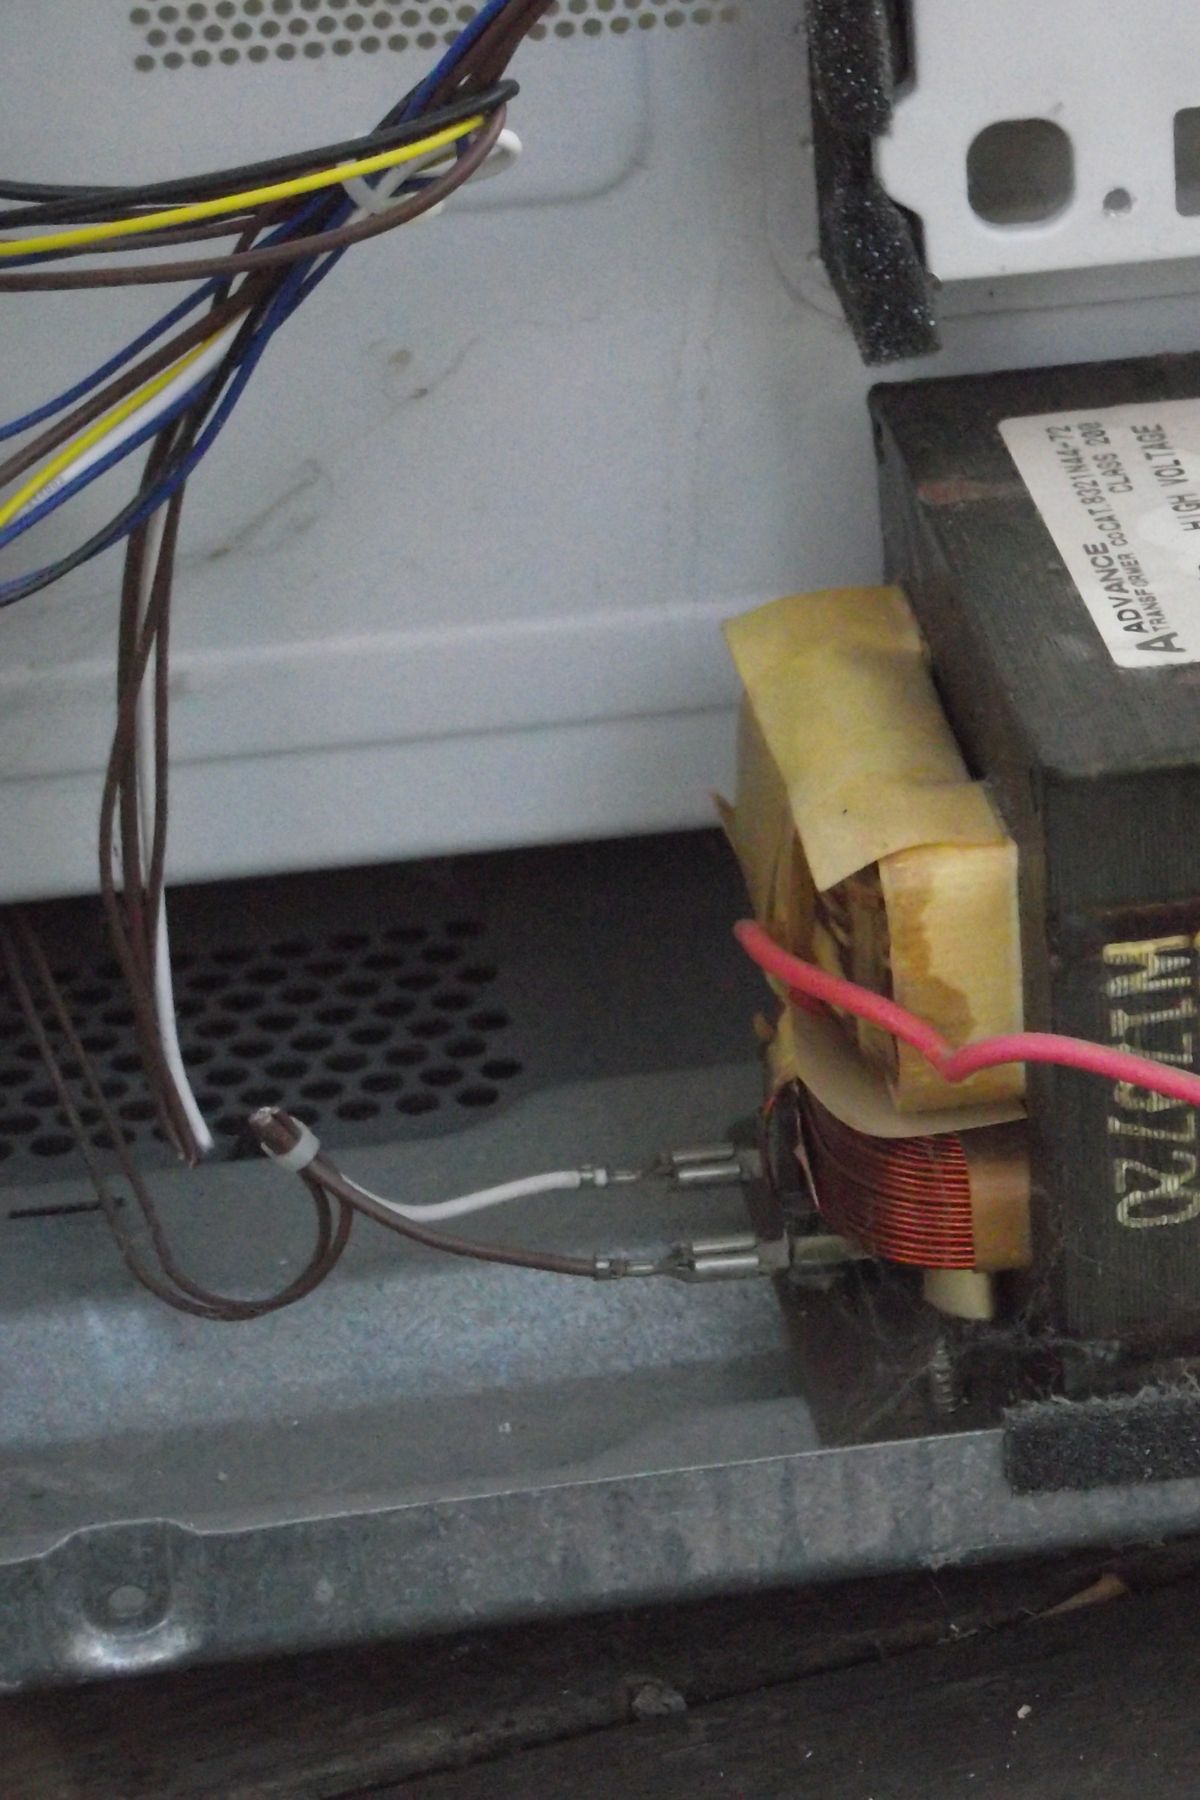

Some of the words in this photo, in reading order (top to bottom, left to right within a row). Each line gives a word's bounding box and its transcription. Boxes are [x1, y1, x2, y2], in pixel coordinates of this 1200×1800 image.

[1077, 421, 1110, 446] 200
[1130, 424, 1189, 487] VOLTAGE
[1091, 452, 1133, 493] CLASS
[1083, 542, 1150, 633] ADVANCE
[1118, 553, 1171, 632] TRANSFORMER
[1136, 632, 1186, 652] A
